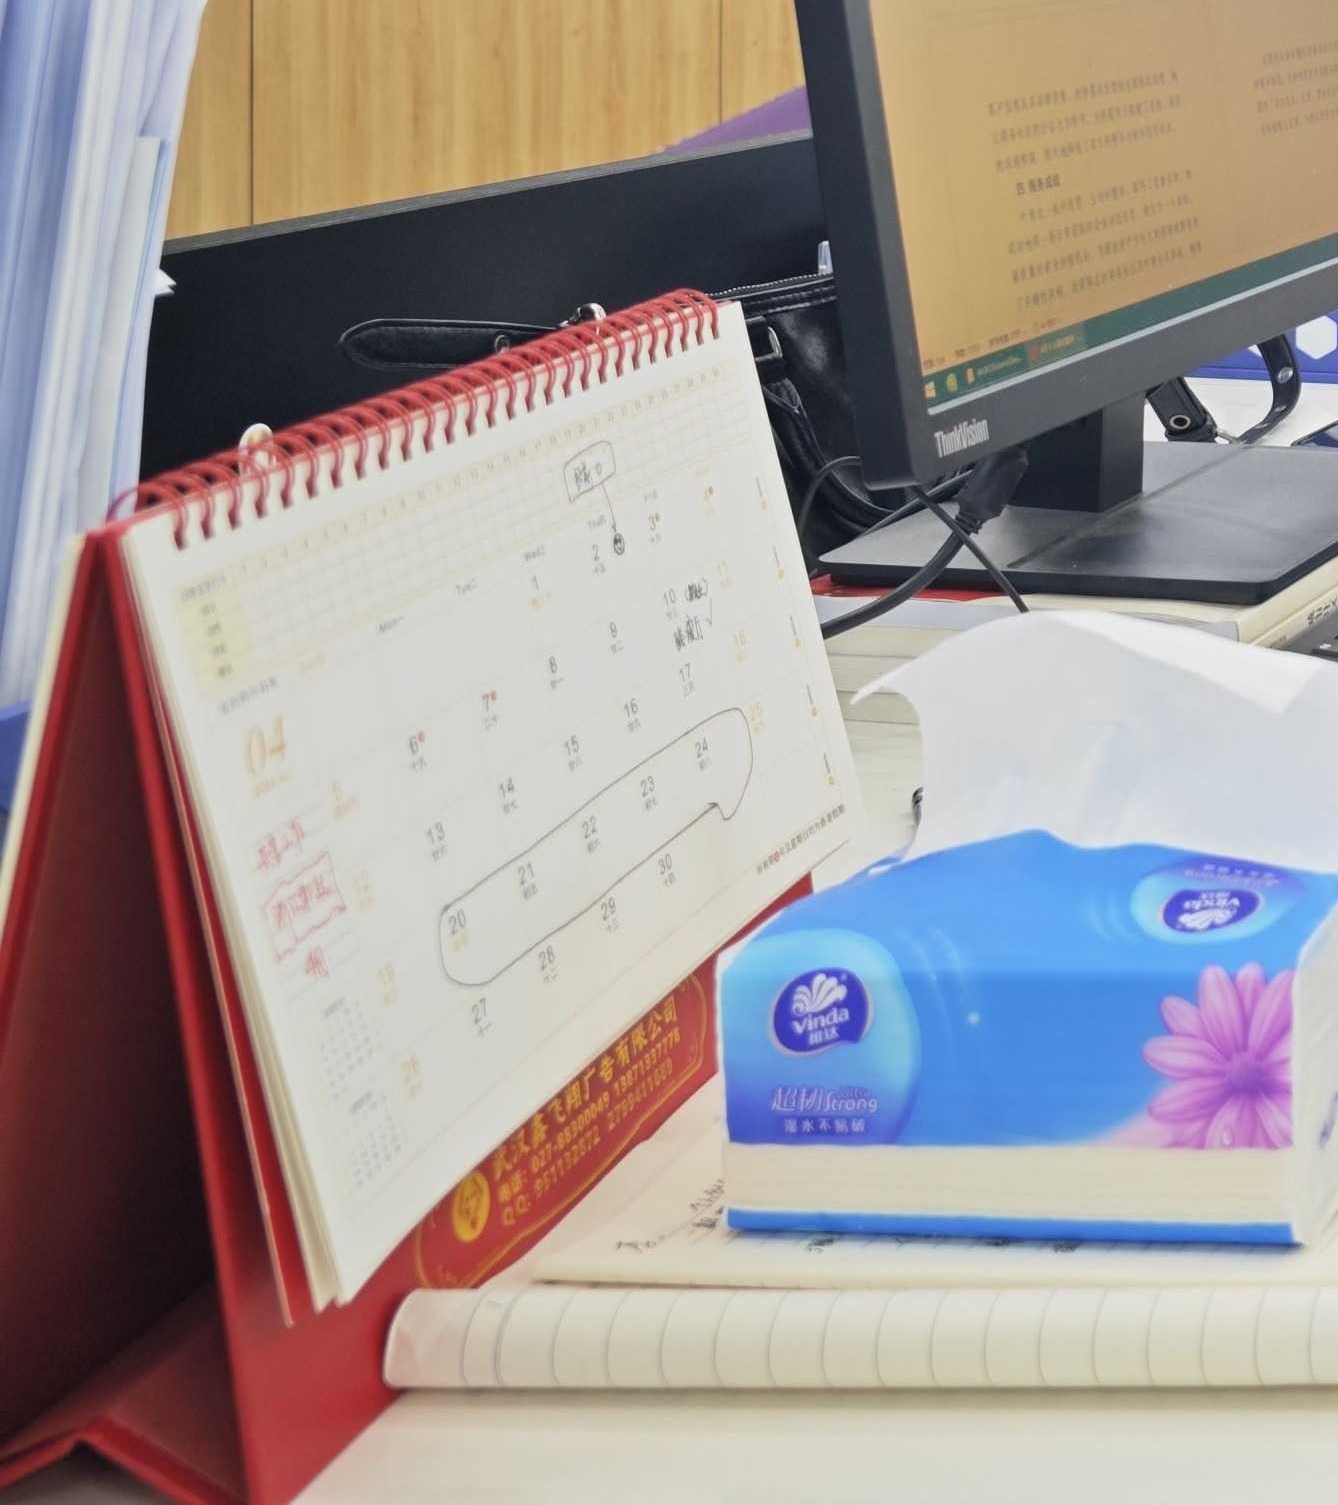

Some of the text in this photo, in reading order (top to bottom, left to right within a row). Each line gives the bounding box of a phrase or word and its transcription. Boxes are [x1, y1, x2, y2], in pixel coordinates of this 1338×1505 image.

[934, 418, 990, 458] ThinkVision
[663, 589, 677, 607] 10
[609, 622, 618, 639] 9
[549, 656, 558, 674] 8
[679, 663, 692, 682] 17
[624, 697, 639, 718] 16
[565, 735, 580, 756] 15
[695, 737, 709, 759] 24
[499, 778, 516, 798] 14
[640, 775, 656, 798] 23
[426, 822, 447, 846] 13
[582, 816, 598, 841] 22
[518, 862, 536, 887] 21
[658, 853, 673, 875] 30
[600, 897, 616, 921] 29
[447, 910, 468, 936] 20
[539, 945, 555, 972] 28
[471, 997, 488, 1026] 27
